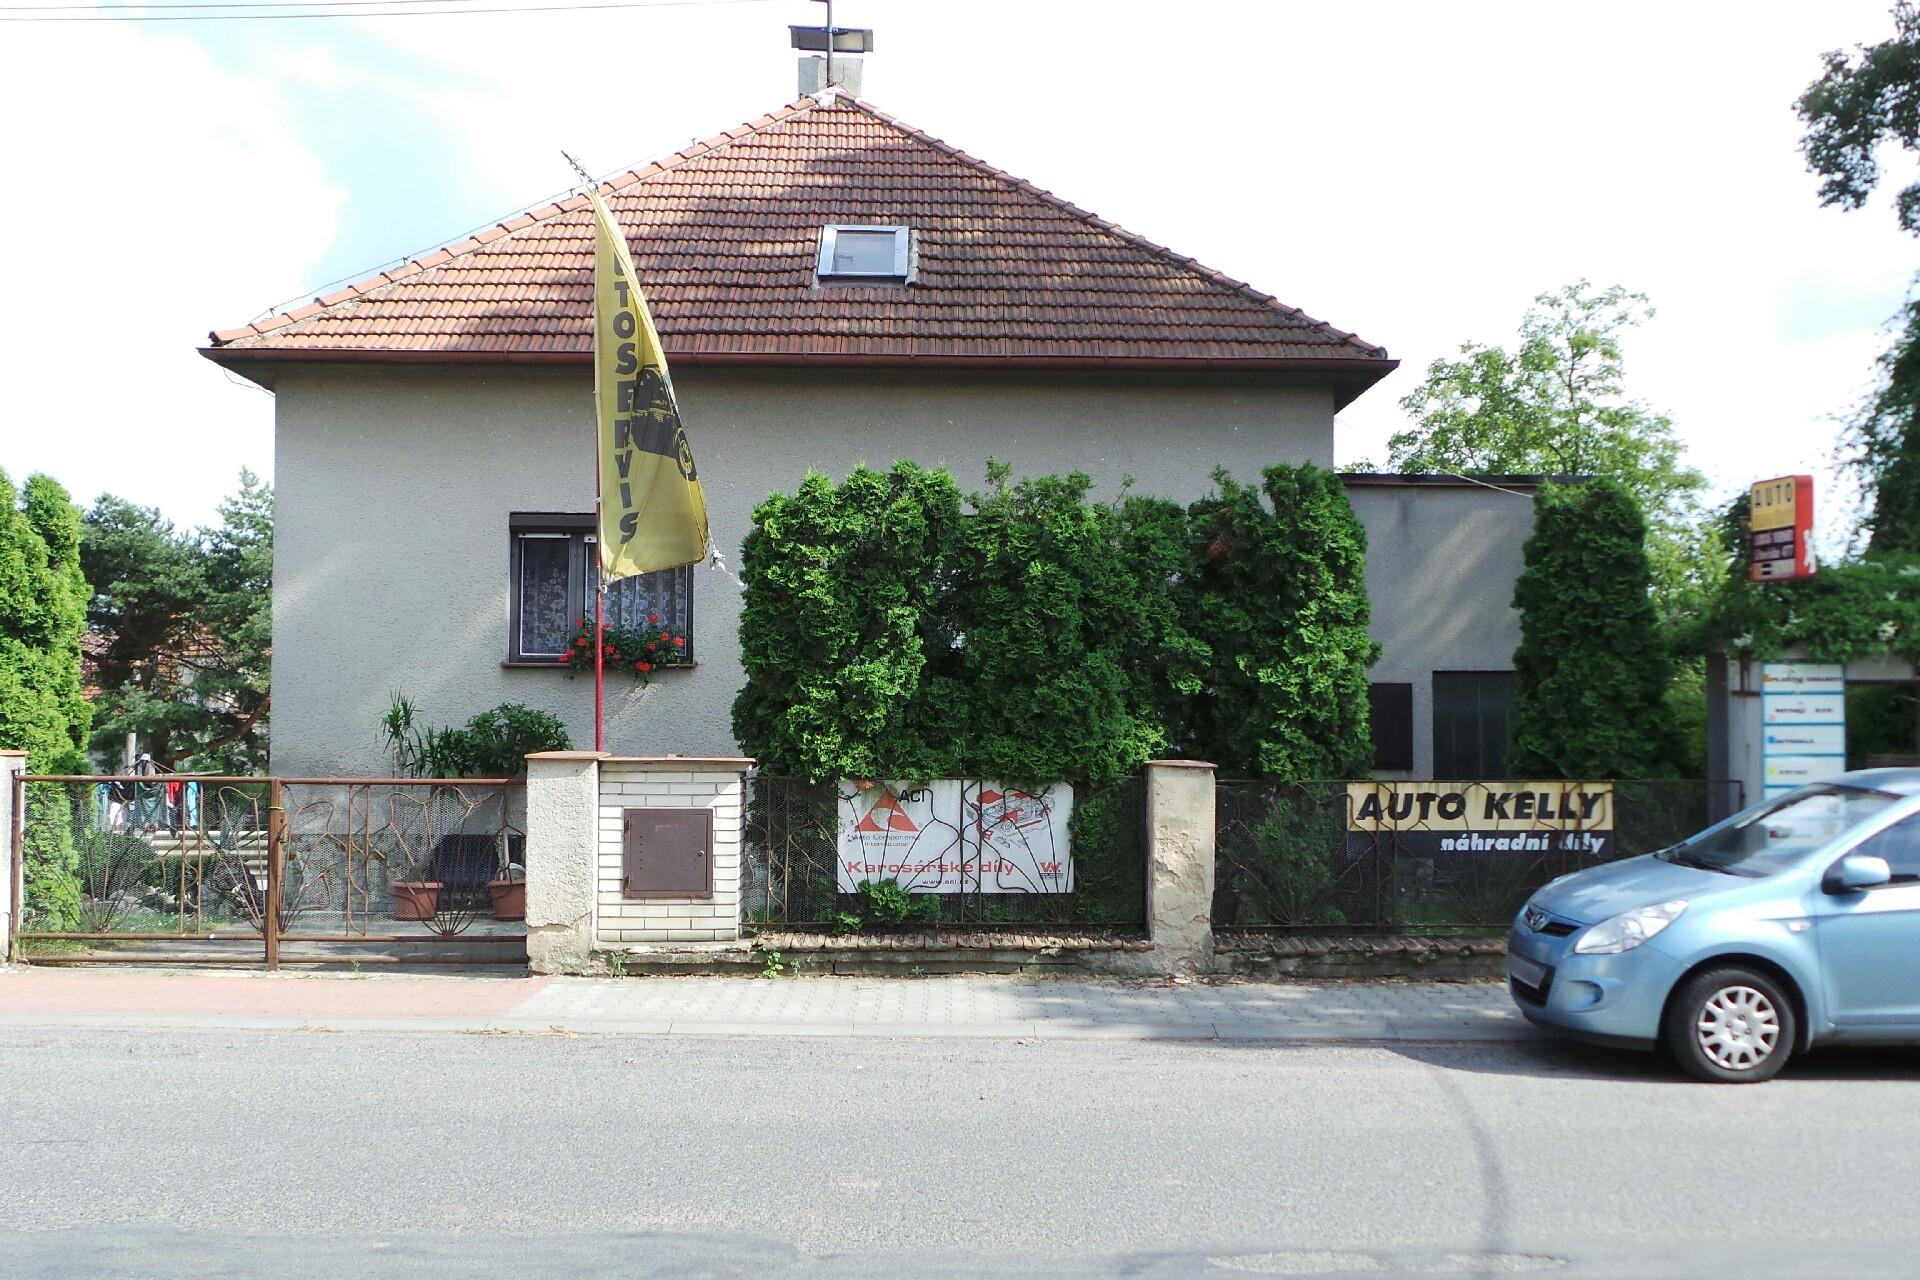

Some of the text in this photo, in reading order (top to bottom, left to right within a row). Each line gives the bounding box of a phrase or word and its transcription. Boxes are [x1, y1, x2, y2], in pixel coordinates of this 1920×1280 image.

[899, 789, 925, 803] ACI
[1355, 792, 1604, 821] AUTO KELLY
[1440, 832, 1550, 851] náhradní
[980, 859, 1014, 875] díly
